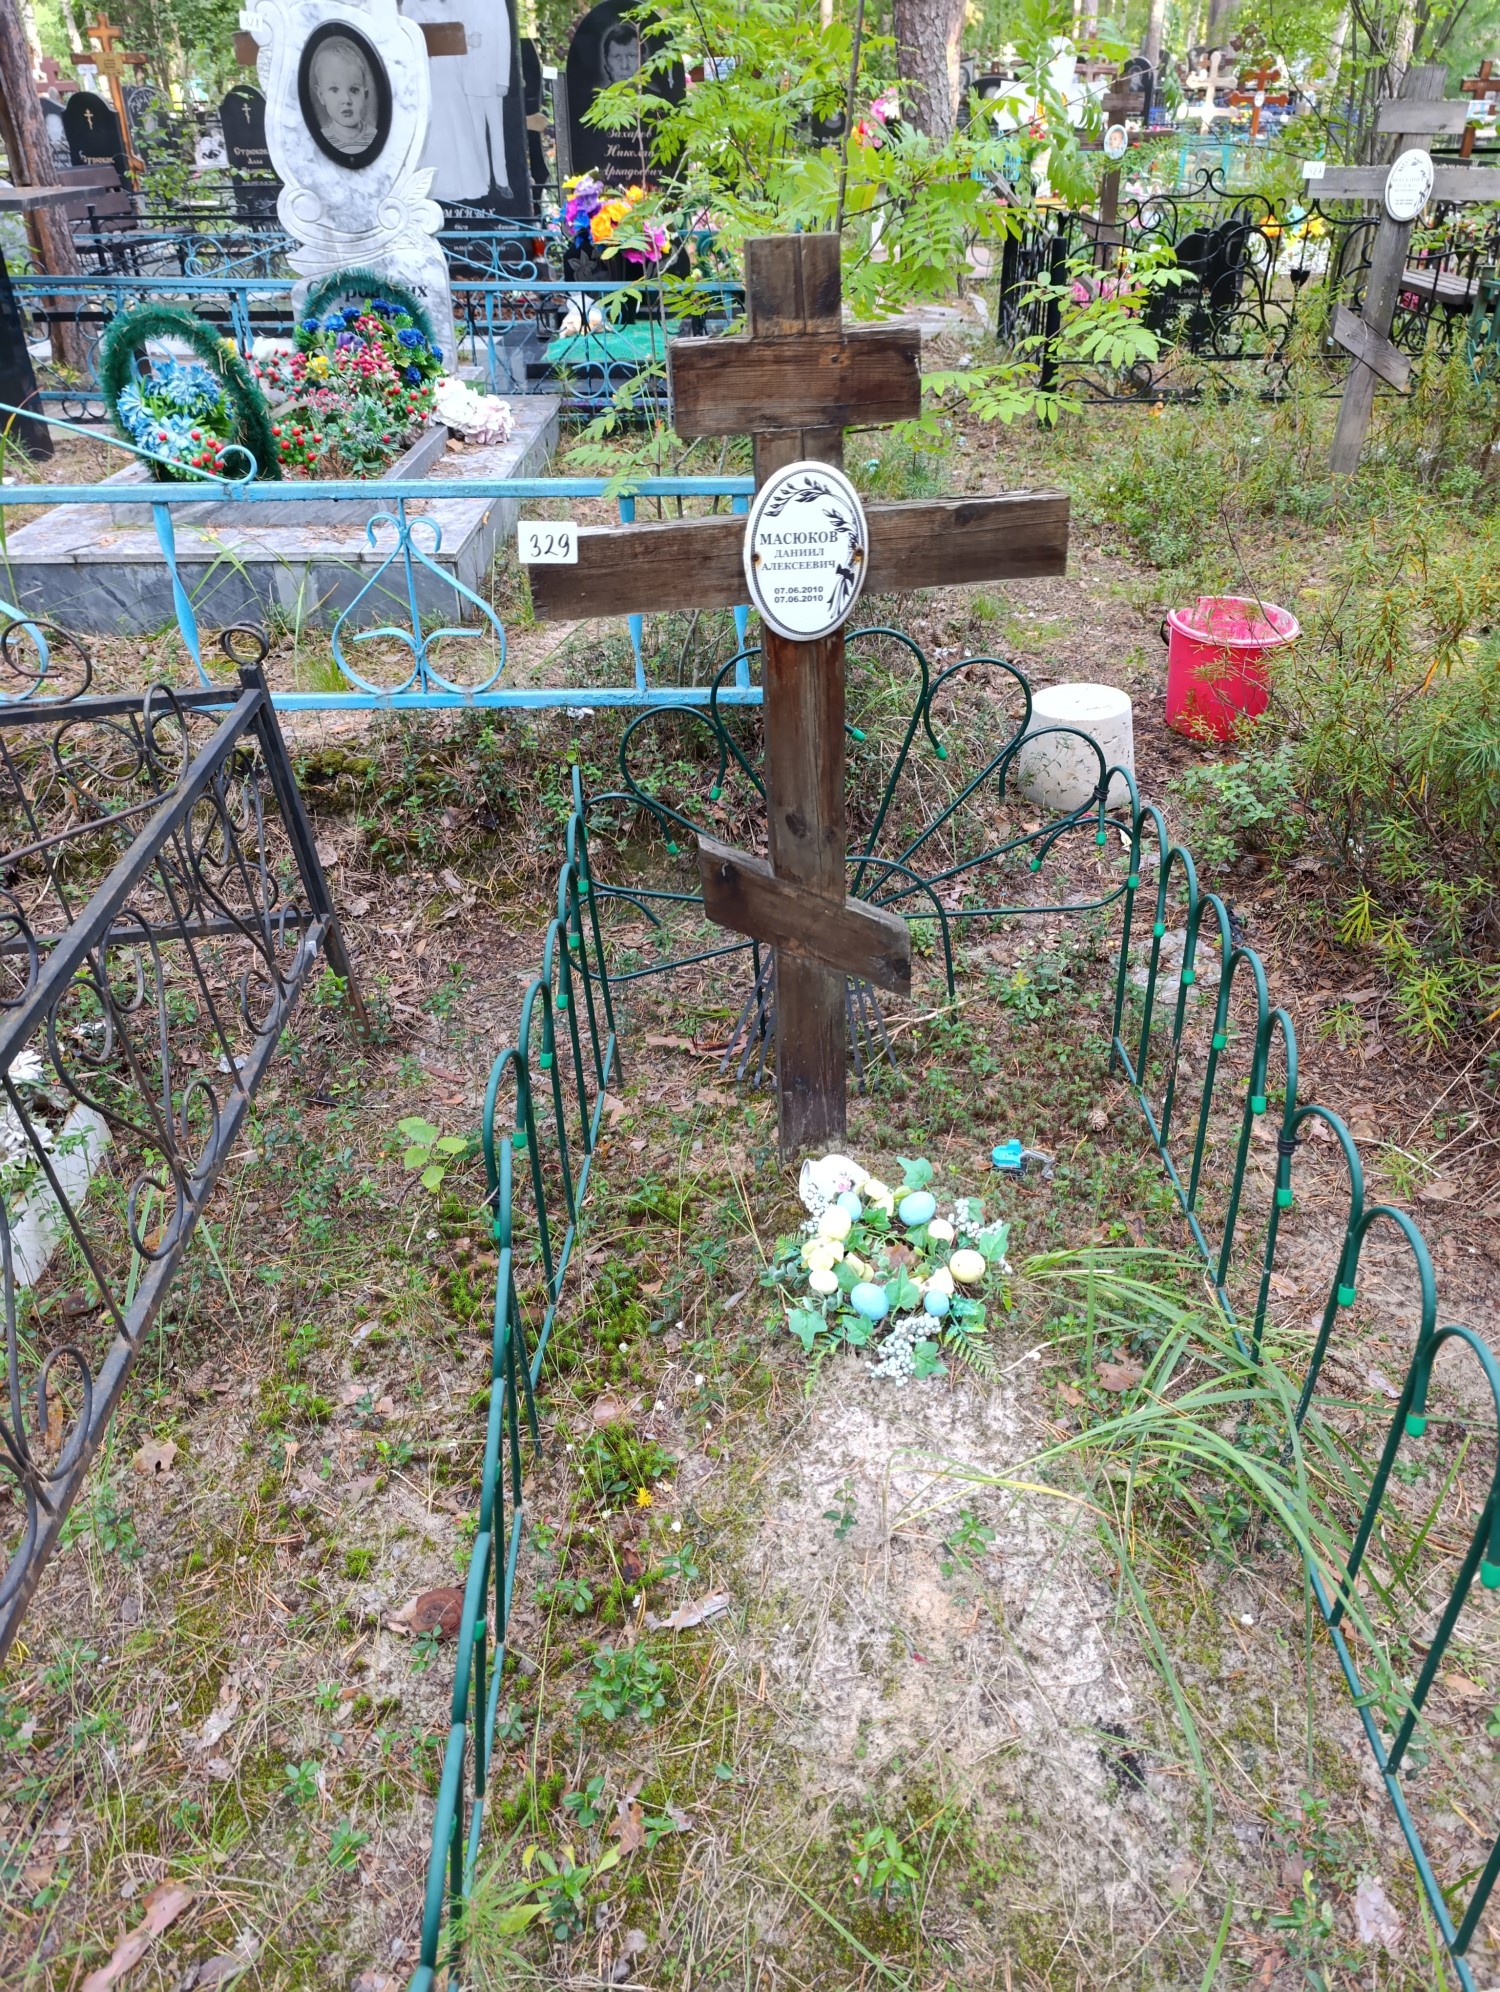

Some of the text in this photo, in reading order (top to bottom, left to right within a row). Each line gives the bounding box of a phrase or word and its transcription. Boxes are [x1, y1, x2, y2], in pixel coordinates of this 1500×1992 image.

[759, 531, 839, 545] МАСЮКОВ
[529, 532, 571, 559] 329
[774, 547, 825, 558] ДАНИИЛ
[761, 560, 836, 571] АЛЕКСЕЕВИЧ
[774, 586, 824, 595] 07.06.2010
[774, 594, 824, 604] 07.06.2010
